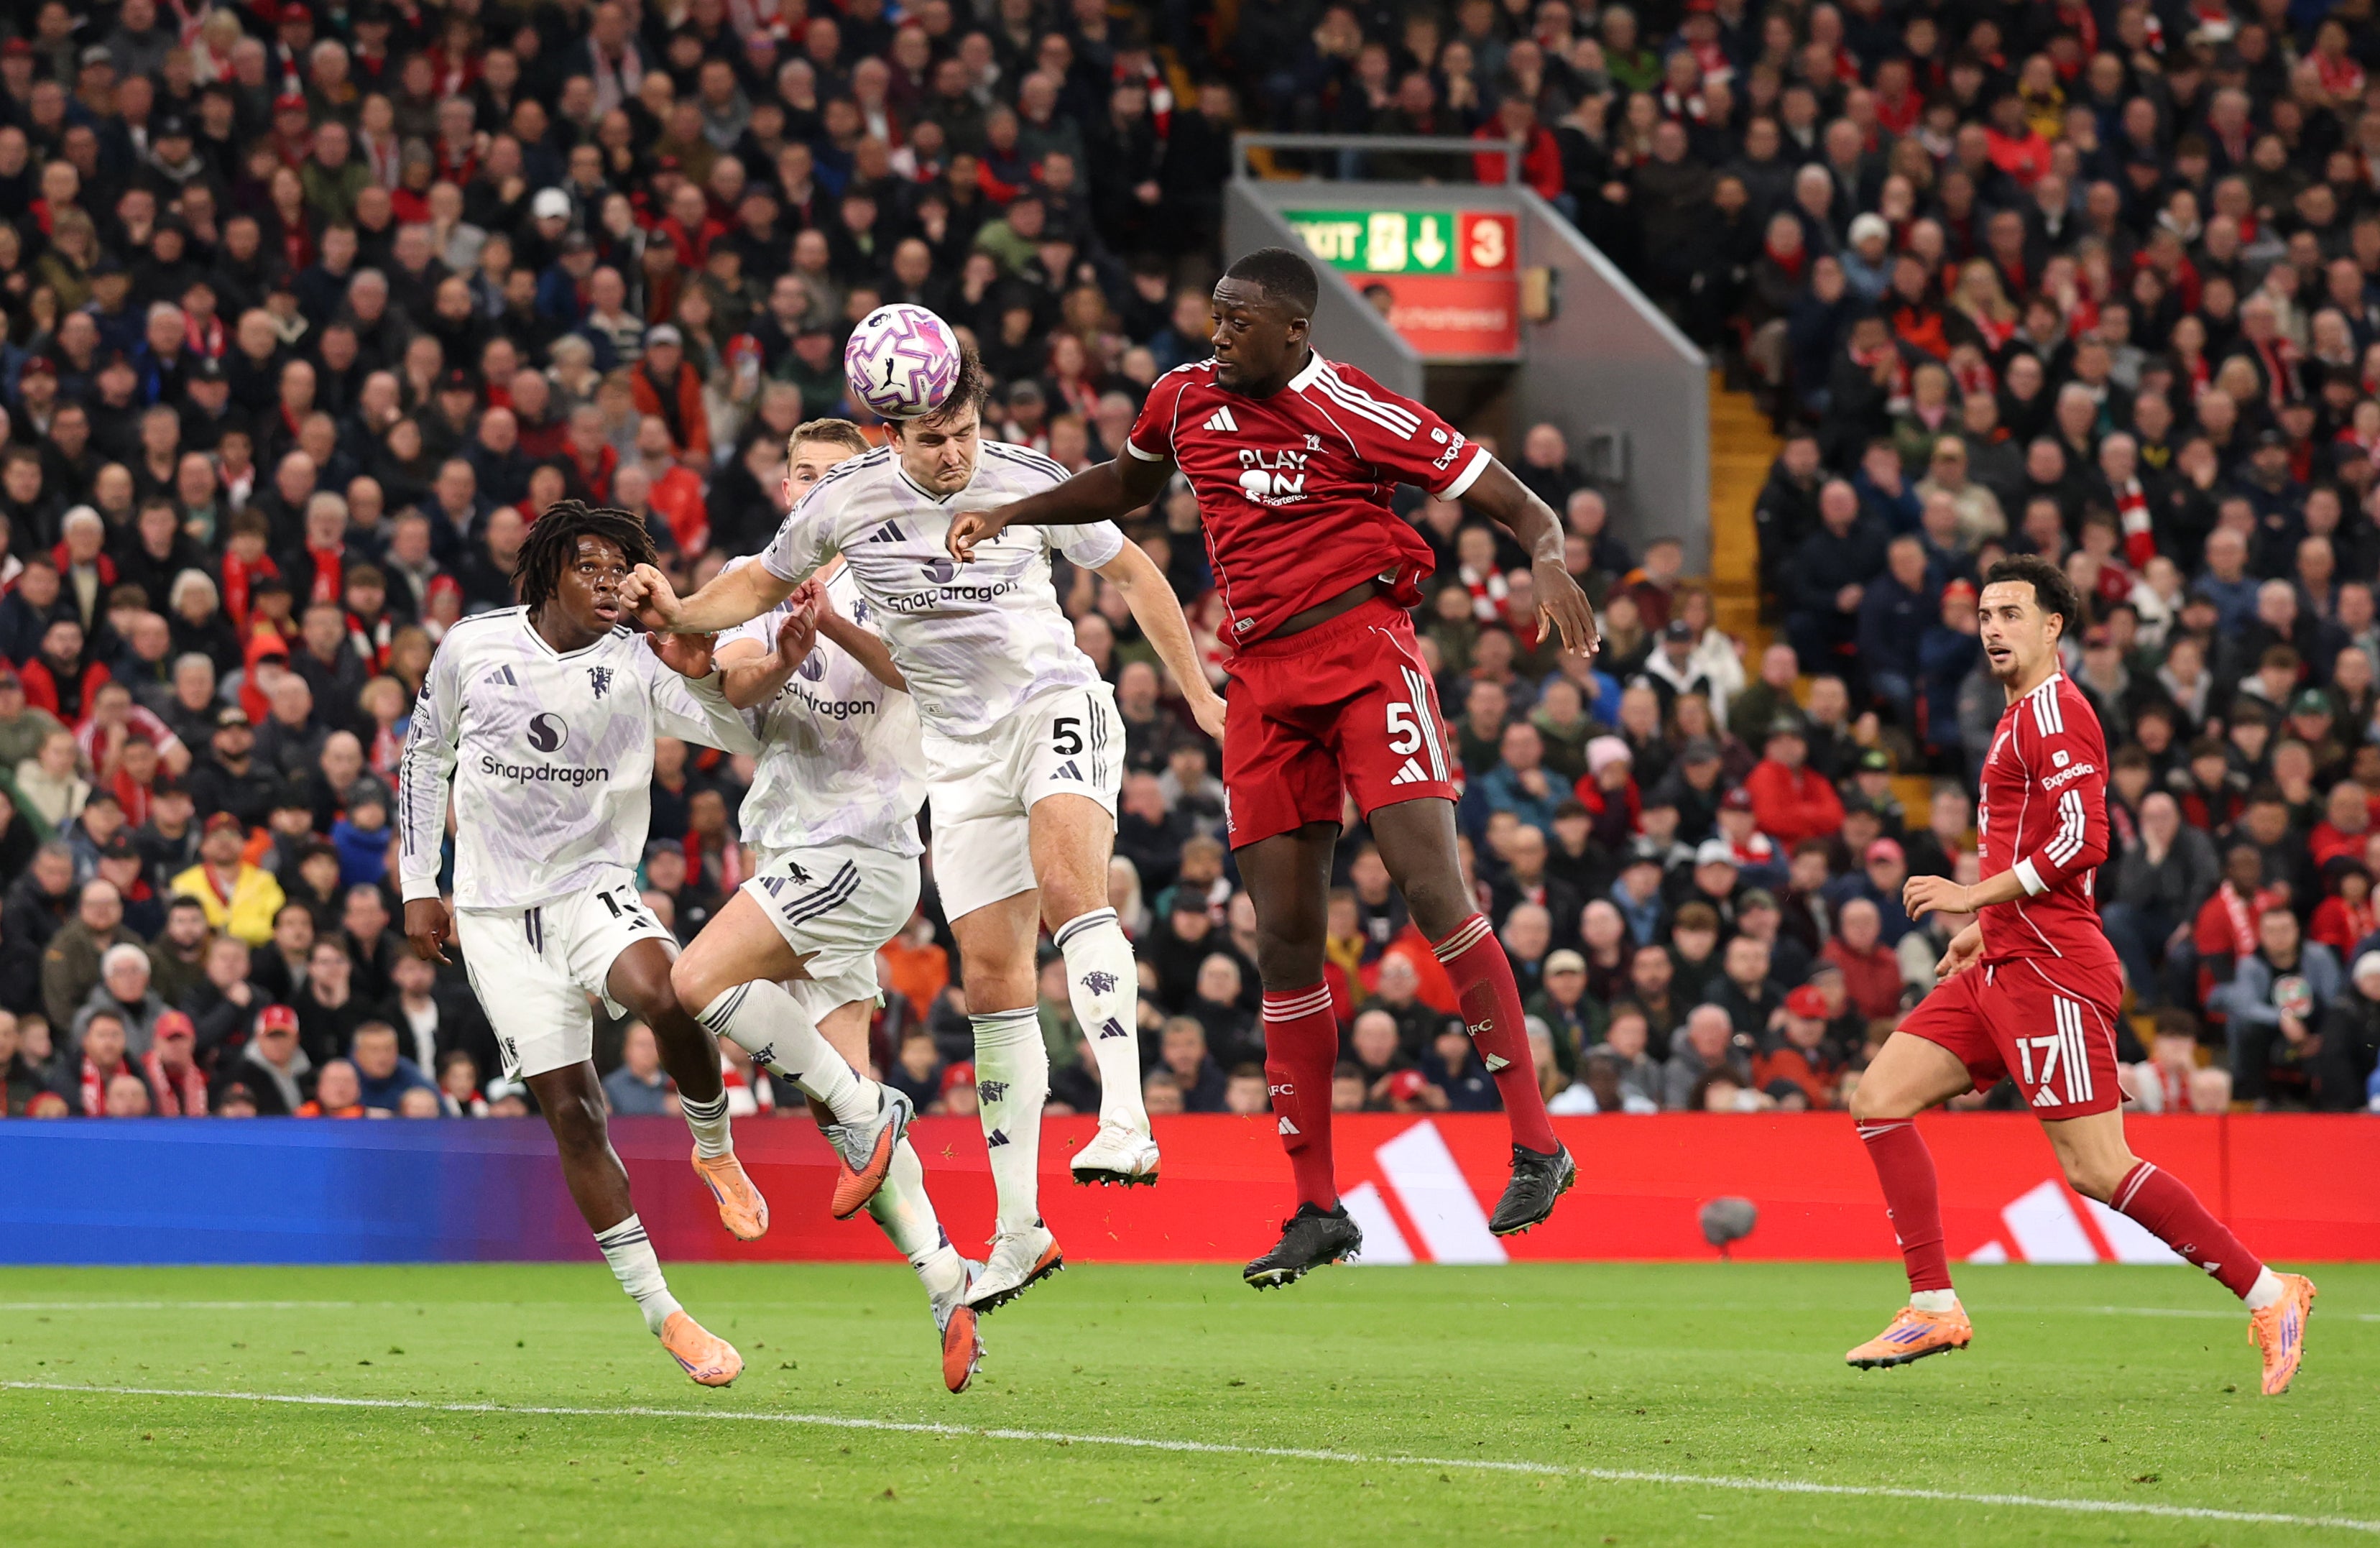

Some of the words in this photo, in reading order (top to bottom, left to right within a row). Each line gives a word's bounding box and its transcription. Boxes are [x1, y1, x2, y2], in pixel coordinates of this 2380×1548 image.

[1470, 218, 1507, 268] 3
[1239, 449, 1308, 470] PLAY
[887, 582, 1019, 612] Snapdragon
[1053, 717, 1083, 755] 5
[1387, 702, 1421, 755] 5
[481, 756, 609, 788] Snapdragon
[2042, 763, 2095, 791] Expedia
[2016, 1035, 2061, 1084] 17
